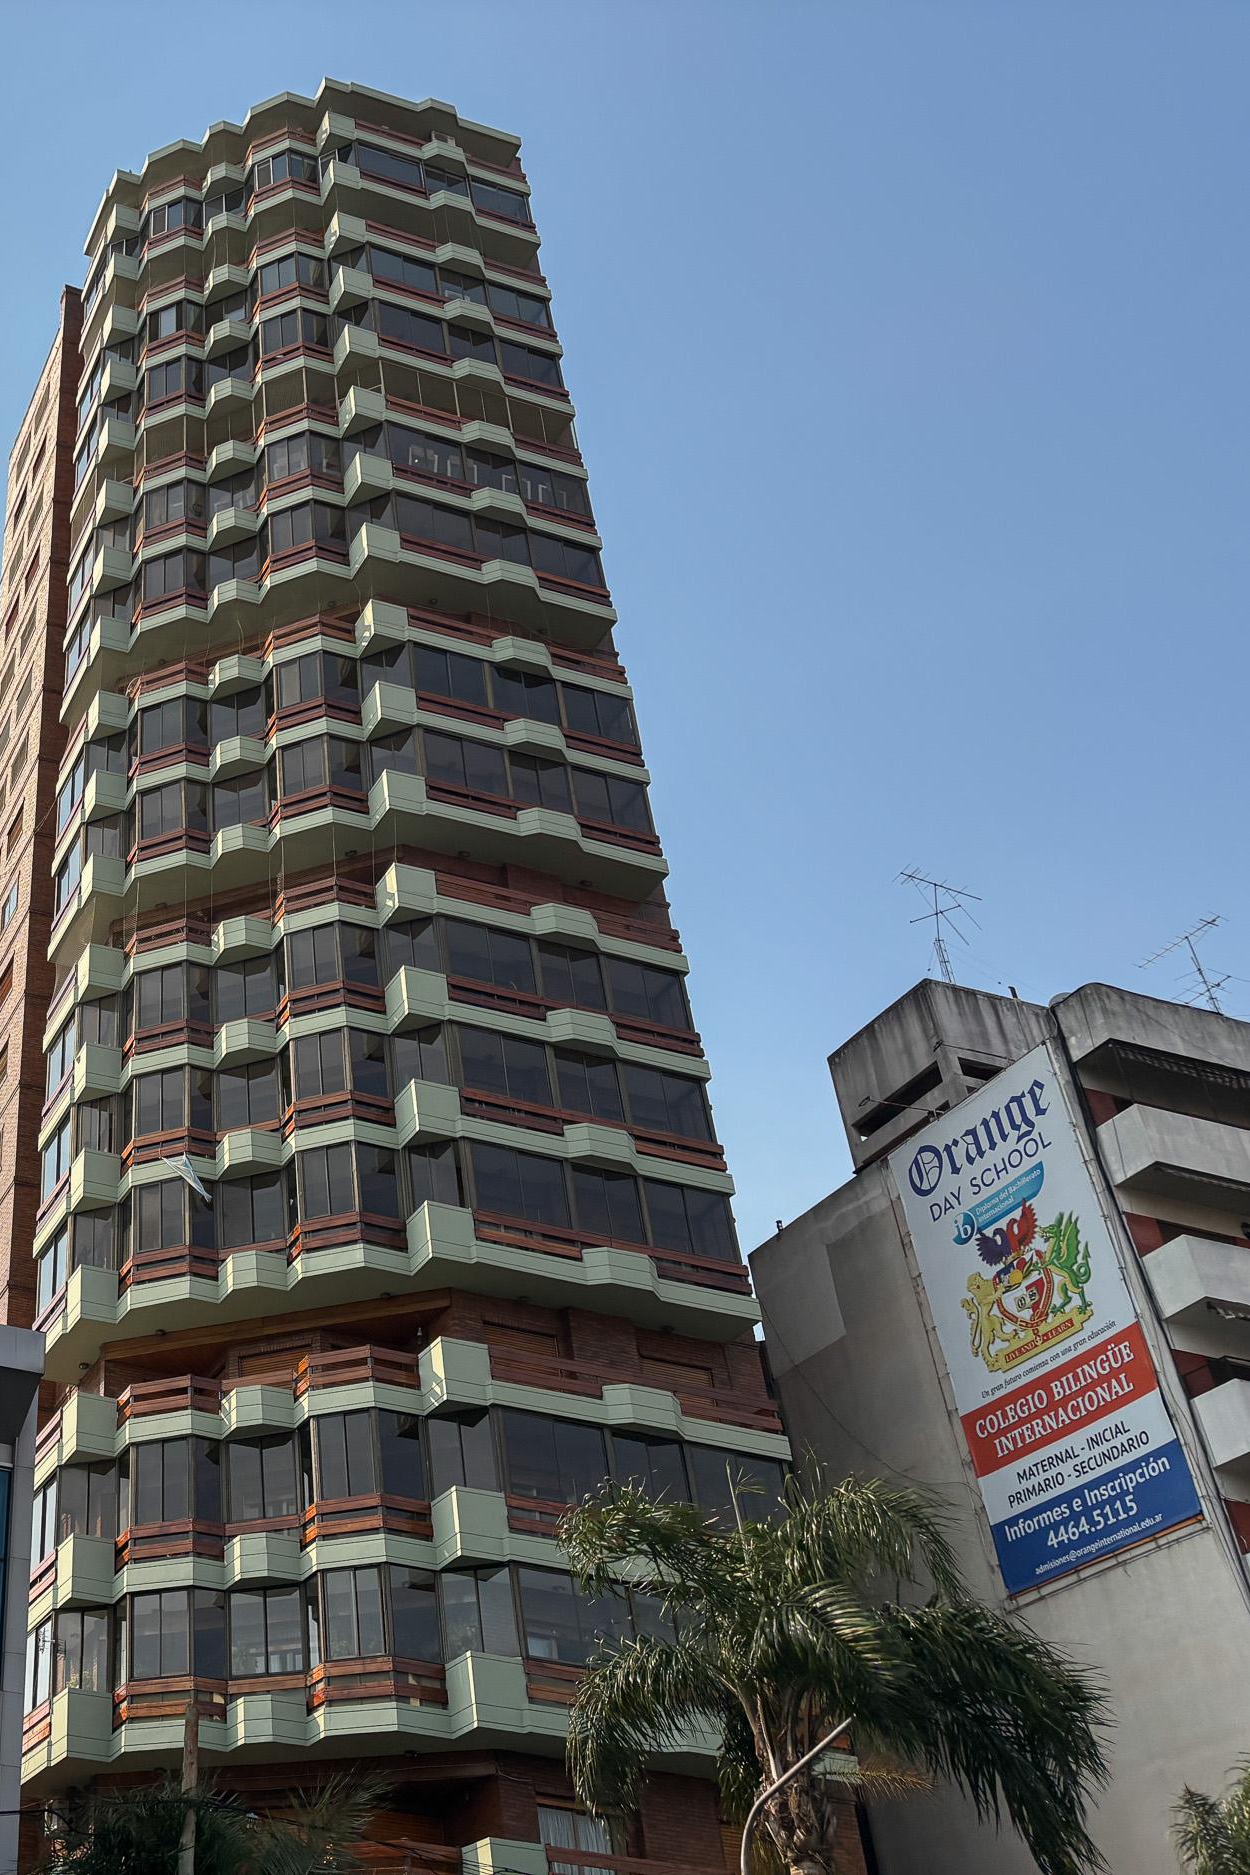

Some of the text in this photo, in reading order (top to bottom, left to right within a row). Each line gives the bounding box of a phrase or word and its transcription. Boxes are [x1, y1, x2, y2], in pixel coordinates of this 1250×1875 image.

[908, 1079, 1051, 1197] Orange
[929, 1131, 1052, 1222] DAY SCHOOL
[954, 1214, 971, 1239] ib
[976, 1169, 1041, 1215] Diploma del Bachillerato
[981, 1320, 1117, 1399] Un gran futuro comienza con una gran educación
[1005, 1321, 1073, 1361] LIVE AND LEARN
[975, 1341, 1134, 1438] COLEGIO BILINGÜE
[994, 1373, 1134, 1458] INTERNACIONAL
[1008, 1471, 1065, 1509] PRIMARIO
[1074, 1430, 1150, 1479] SECUNDARIO
[1016, 1445, 1079, 1485] MATERNAL
[1085, 1420, 1131, 1452] INICIAL
[1005, 1456, 1171, 1542] Informes e Inscripción
[1047, 1494, 1138, 1549] 4464.5115
[1035, 1512, 1164, 1575] admisiones@orangeinternational.edu.ar
